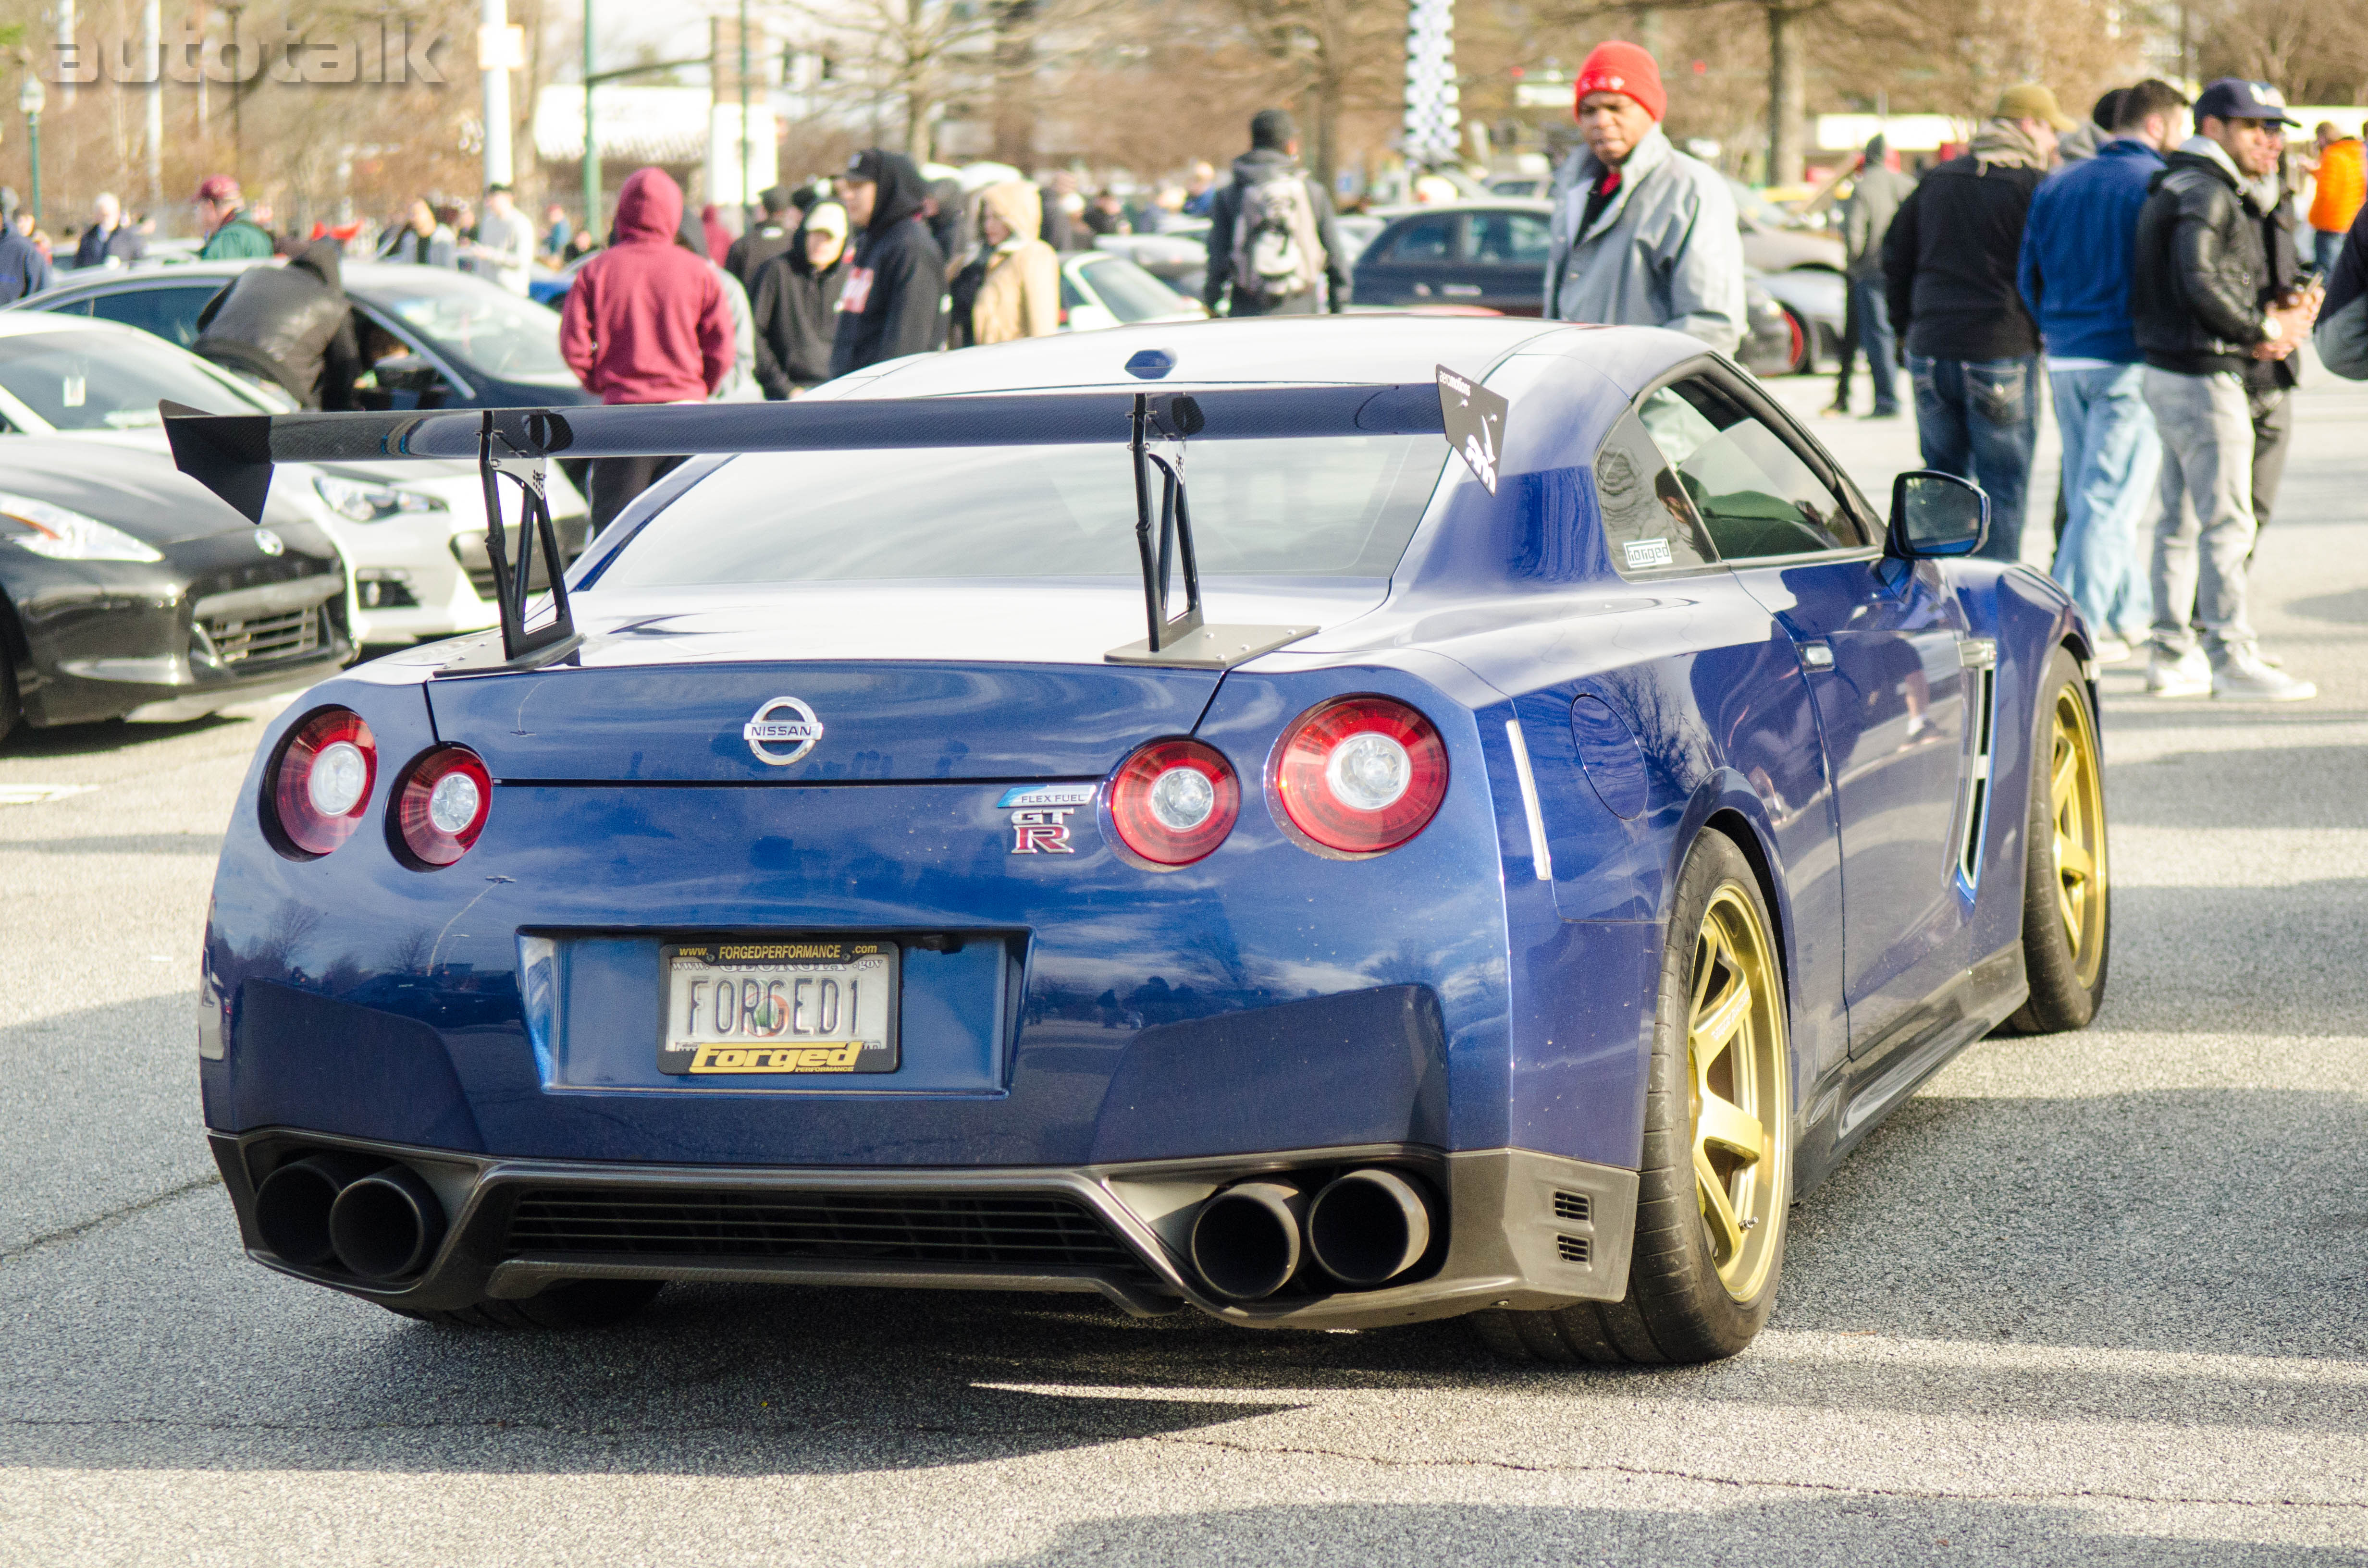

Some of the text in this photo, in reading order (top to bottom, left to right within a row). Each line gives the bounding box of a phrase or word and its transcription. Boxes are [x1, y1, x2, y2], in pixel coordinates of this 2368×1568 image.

[751, 726, 811, 736] NISSAN
[1021, 795, 1052, 803] FLEX
[679, 945, 877, 959] www. FORGEDPERFORMANCE .com
[688, 976, 861, 1036] FORGED1
